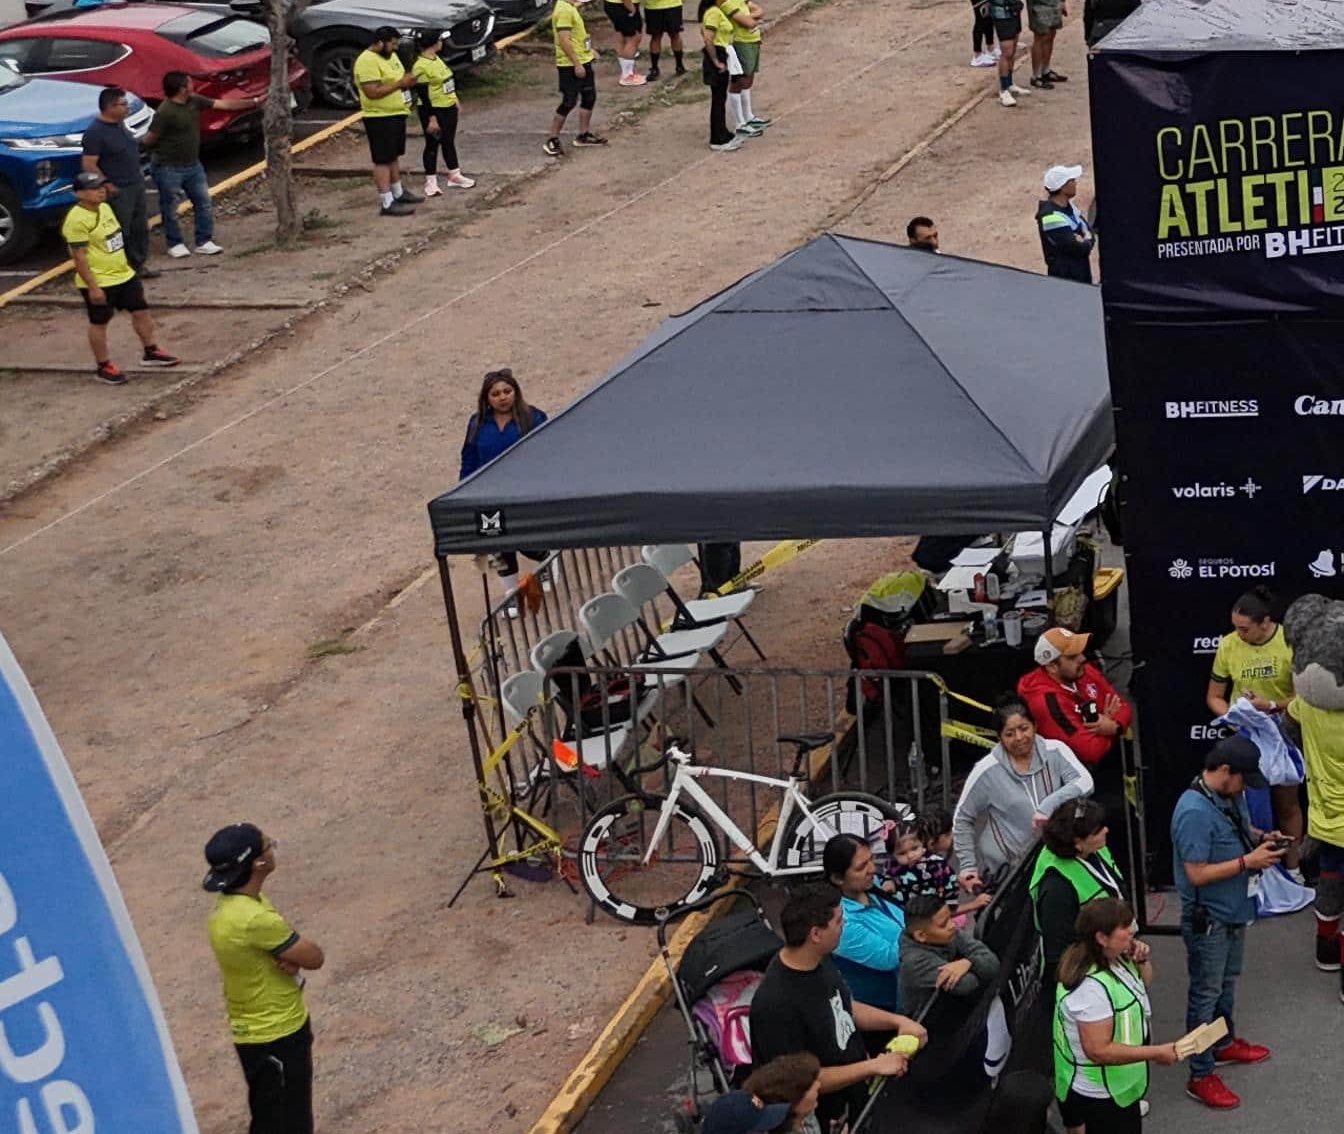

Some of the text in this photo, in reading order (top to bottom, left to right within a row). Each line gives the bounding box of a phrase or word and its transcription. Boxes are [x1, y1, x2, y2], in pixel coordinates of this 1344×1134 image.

[1157, 169, 1311, 239] ATLETI
[1158, 235, 1234, 259] PRESENTADA
[1237, 234, 1260, 250] POR
[1165, 400, 1259, 418] BHFITNESS
[1171, 482, 1235, 498] volaris
[1199, 562, 1275, 578] EL POTOSÍ
